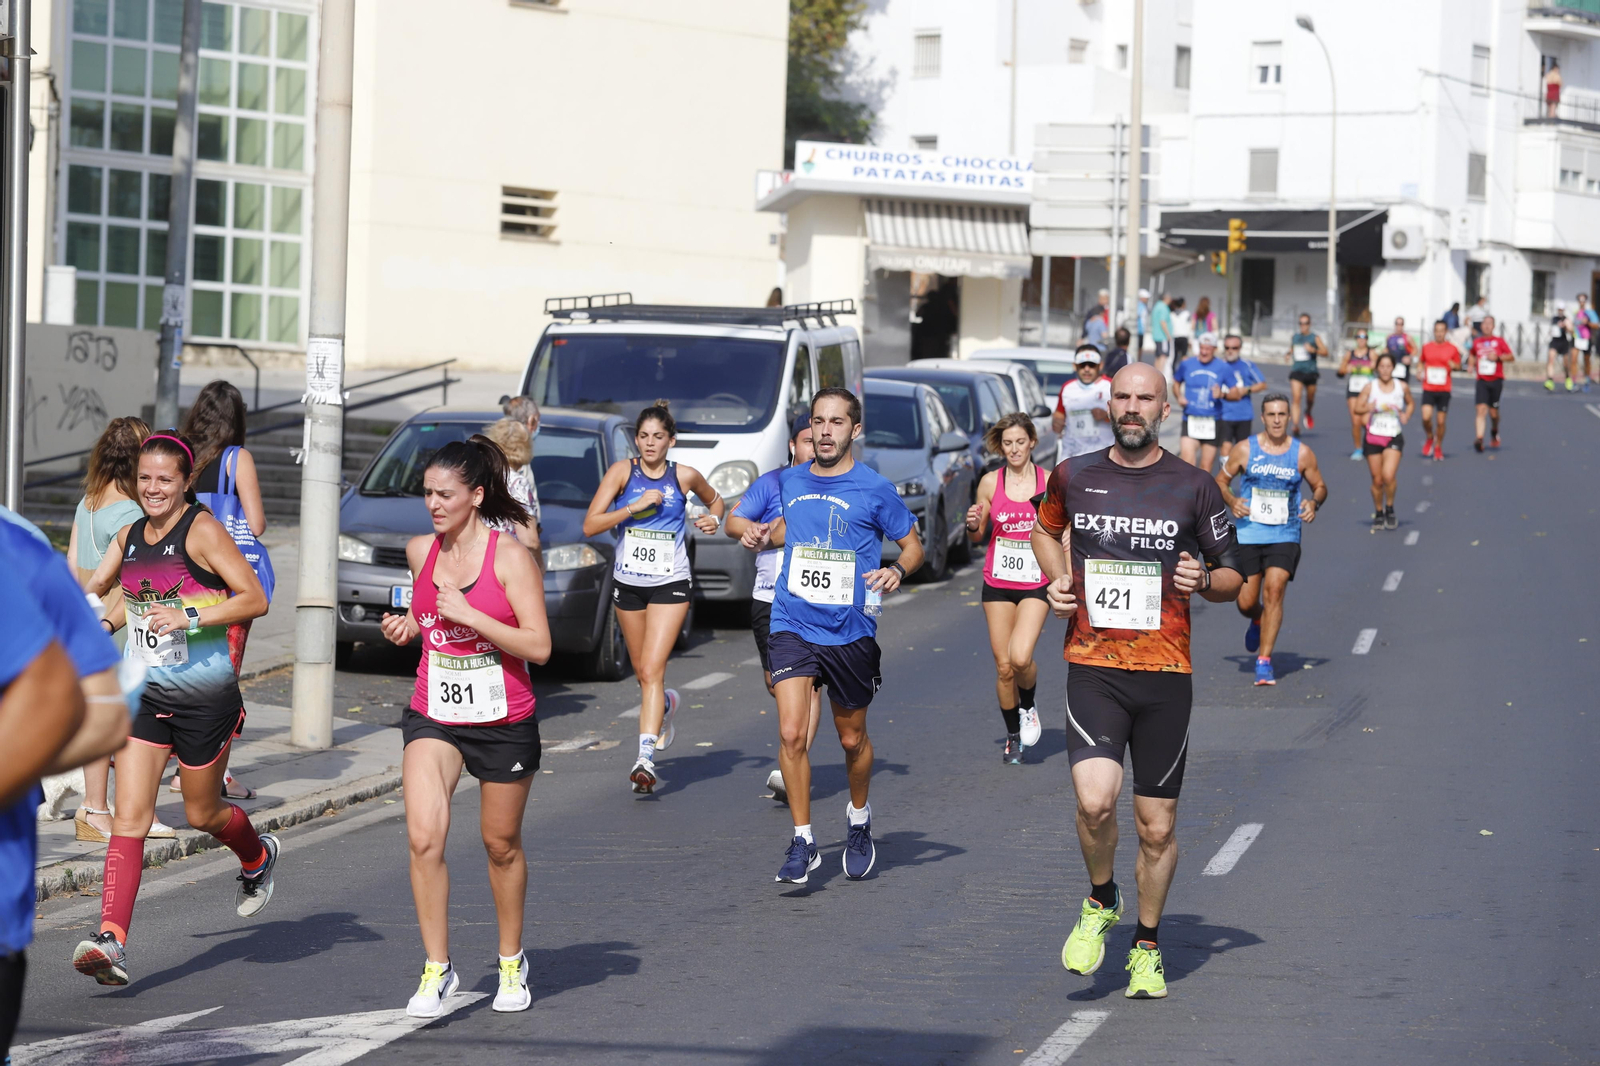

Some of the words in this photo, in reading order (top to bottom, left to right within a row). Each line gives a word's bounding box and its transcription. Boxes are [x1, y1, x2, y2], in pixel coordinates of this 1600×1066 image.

[825, 148, 922, 166] CHURROS
[853, 166, 946, 183] PATATAS
[953, 173, 1025, 188] FRITAS
[1250, 463, 1295, 477] Golfitness
[1260, 503, 1273, 514] 95
[1074, 513, 1179, 538] EXTREMO
[1130, 536, 1175, 551] FILOS
[632, 547, 656, 562] 498
[804, 550, 823, 559] VUELTA
[829, 552, 851, 561] HUELVA
[1001, 555, 1024, 570] 380
[1099, 564, 1123, 574] VUELTA
[1125, 565, 1130, 574] A
[1131, 565, 1157, 575] HUELVA
[800, 569, 831, 589] 565
[1095, 587, 1131, 610] 421
[134, 626, 158, 649] 176
[441, 656, 462, 669] VUELTA
[463, 659, 469, 669] A
[469, 655, 496, 669] HUELVA
[440, 681, 474, 705] 381
